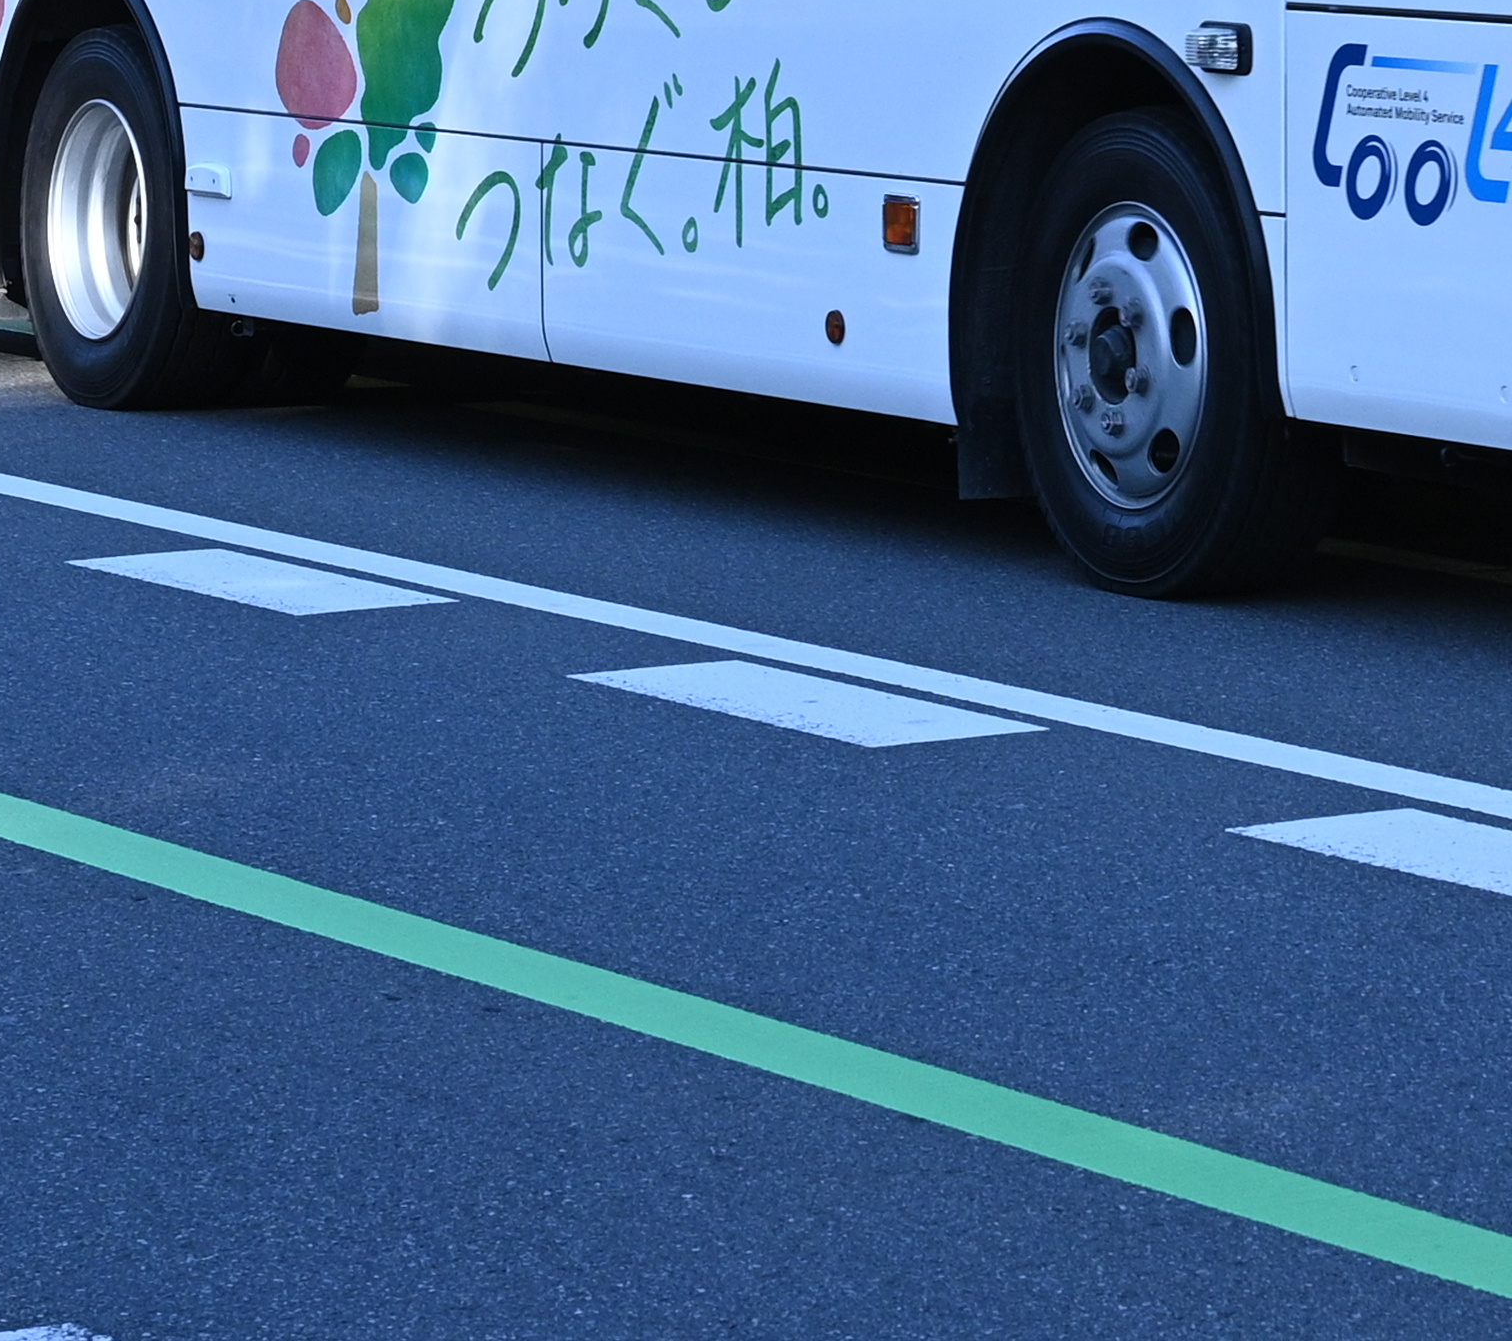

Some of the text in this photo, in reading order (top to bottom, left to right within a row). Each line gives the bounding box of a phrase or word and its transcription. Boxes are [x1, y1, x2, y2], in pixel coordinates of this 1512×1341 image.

[1346, 84, 1397, 102] Cooperative
[1398, 88, 1422, 102] Level
[1346, 103, 1465, 125] Automated Mobility Service
